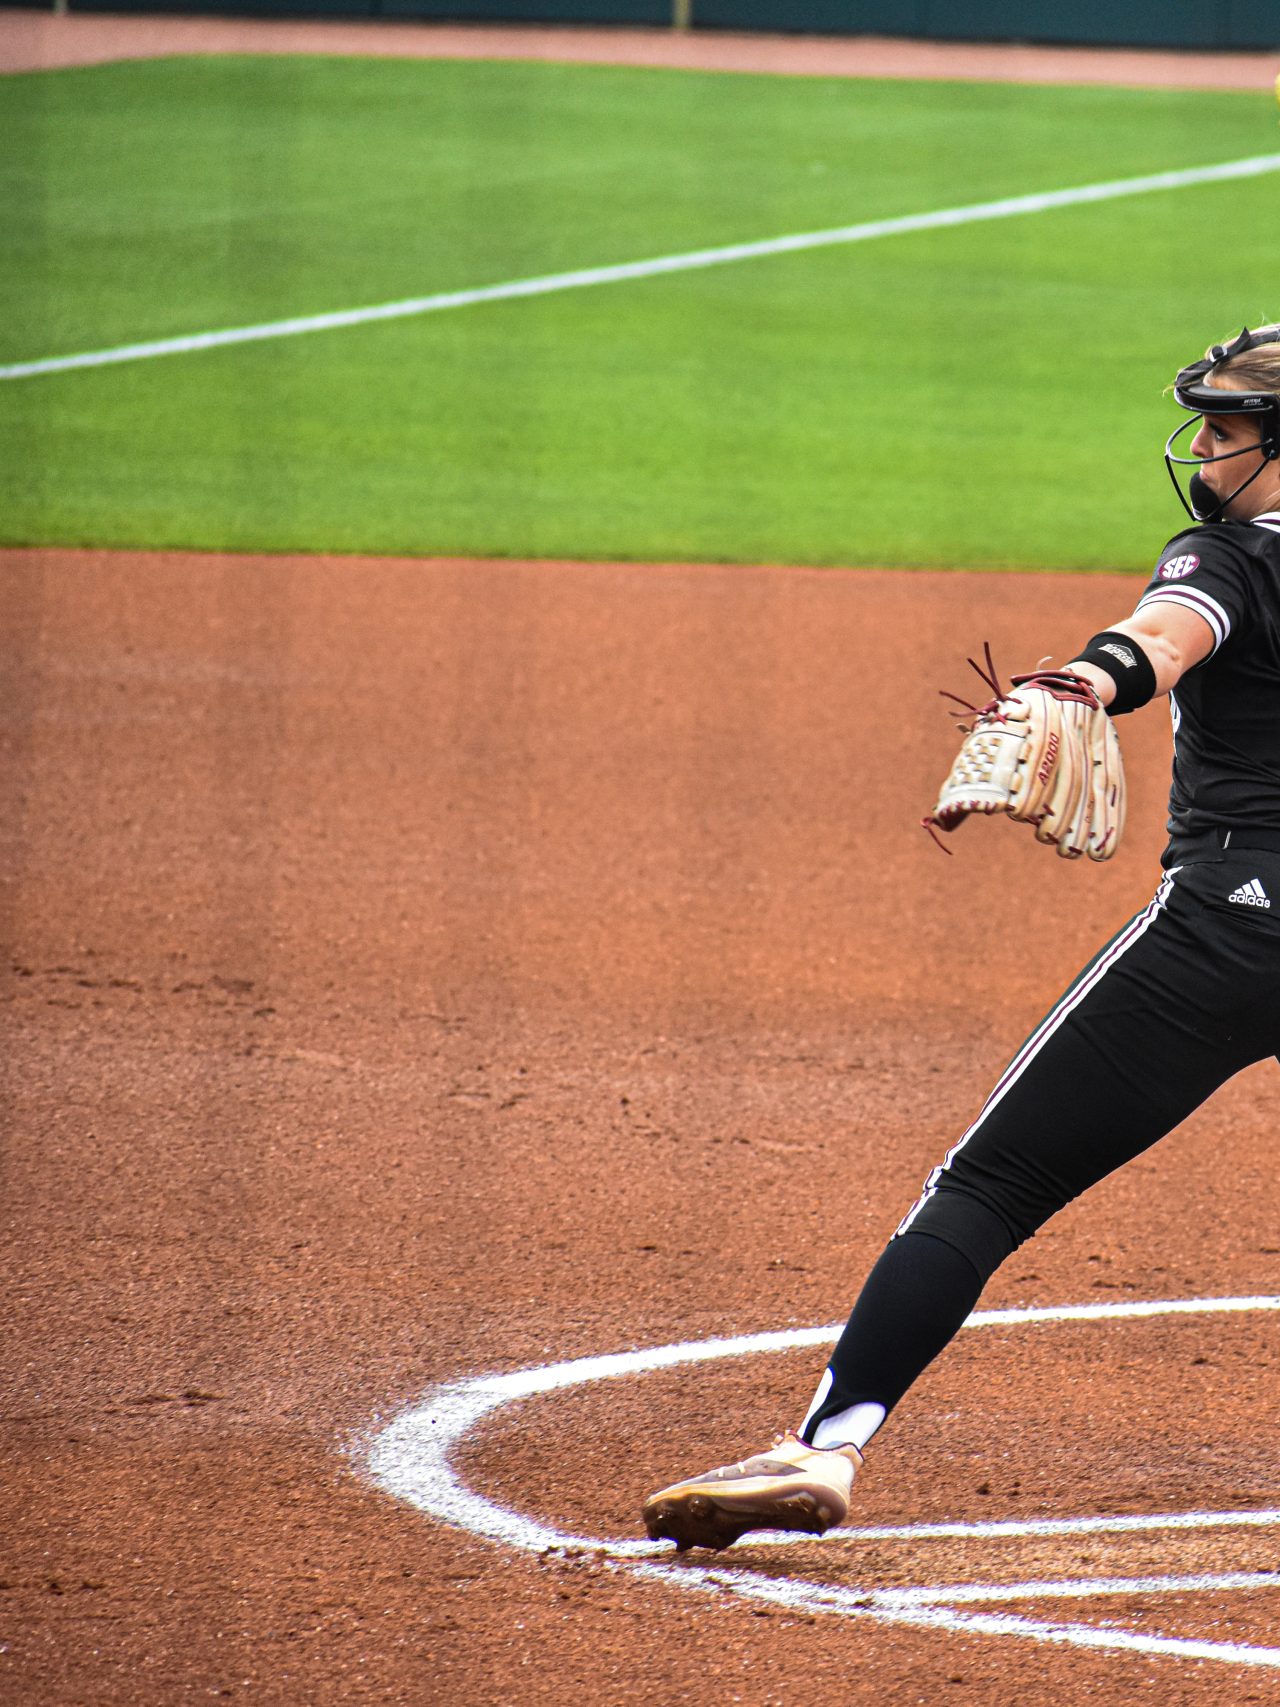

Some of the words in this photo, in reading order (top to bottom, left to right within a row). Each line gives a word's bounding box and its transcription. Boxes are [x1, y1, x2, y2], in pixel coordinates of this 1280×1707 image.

[1161, 554, 1197, 579] SEC
[1038, 732, 1060, 786] A2000
[1228, 893, 1271, 909] adidas
